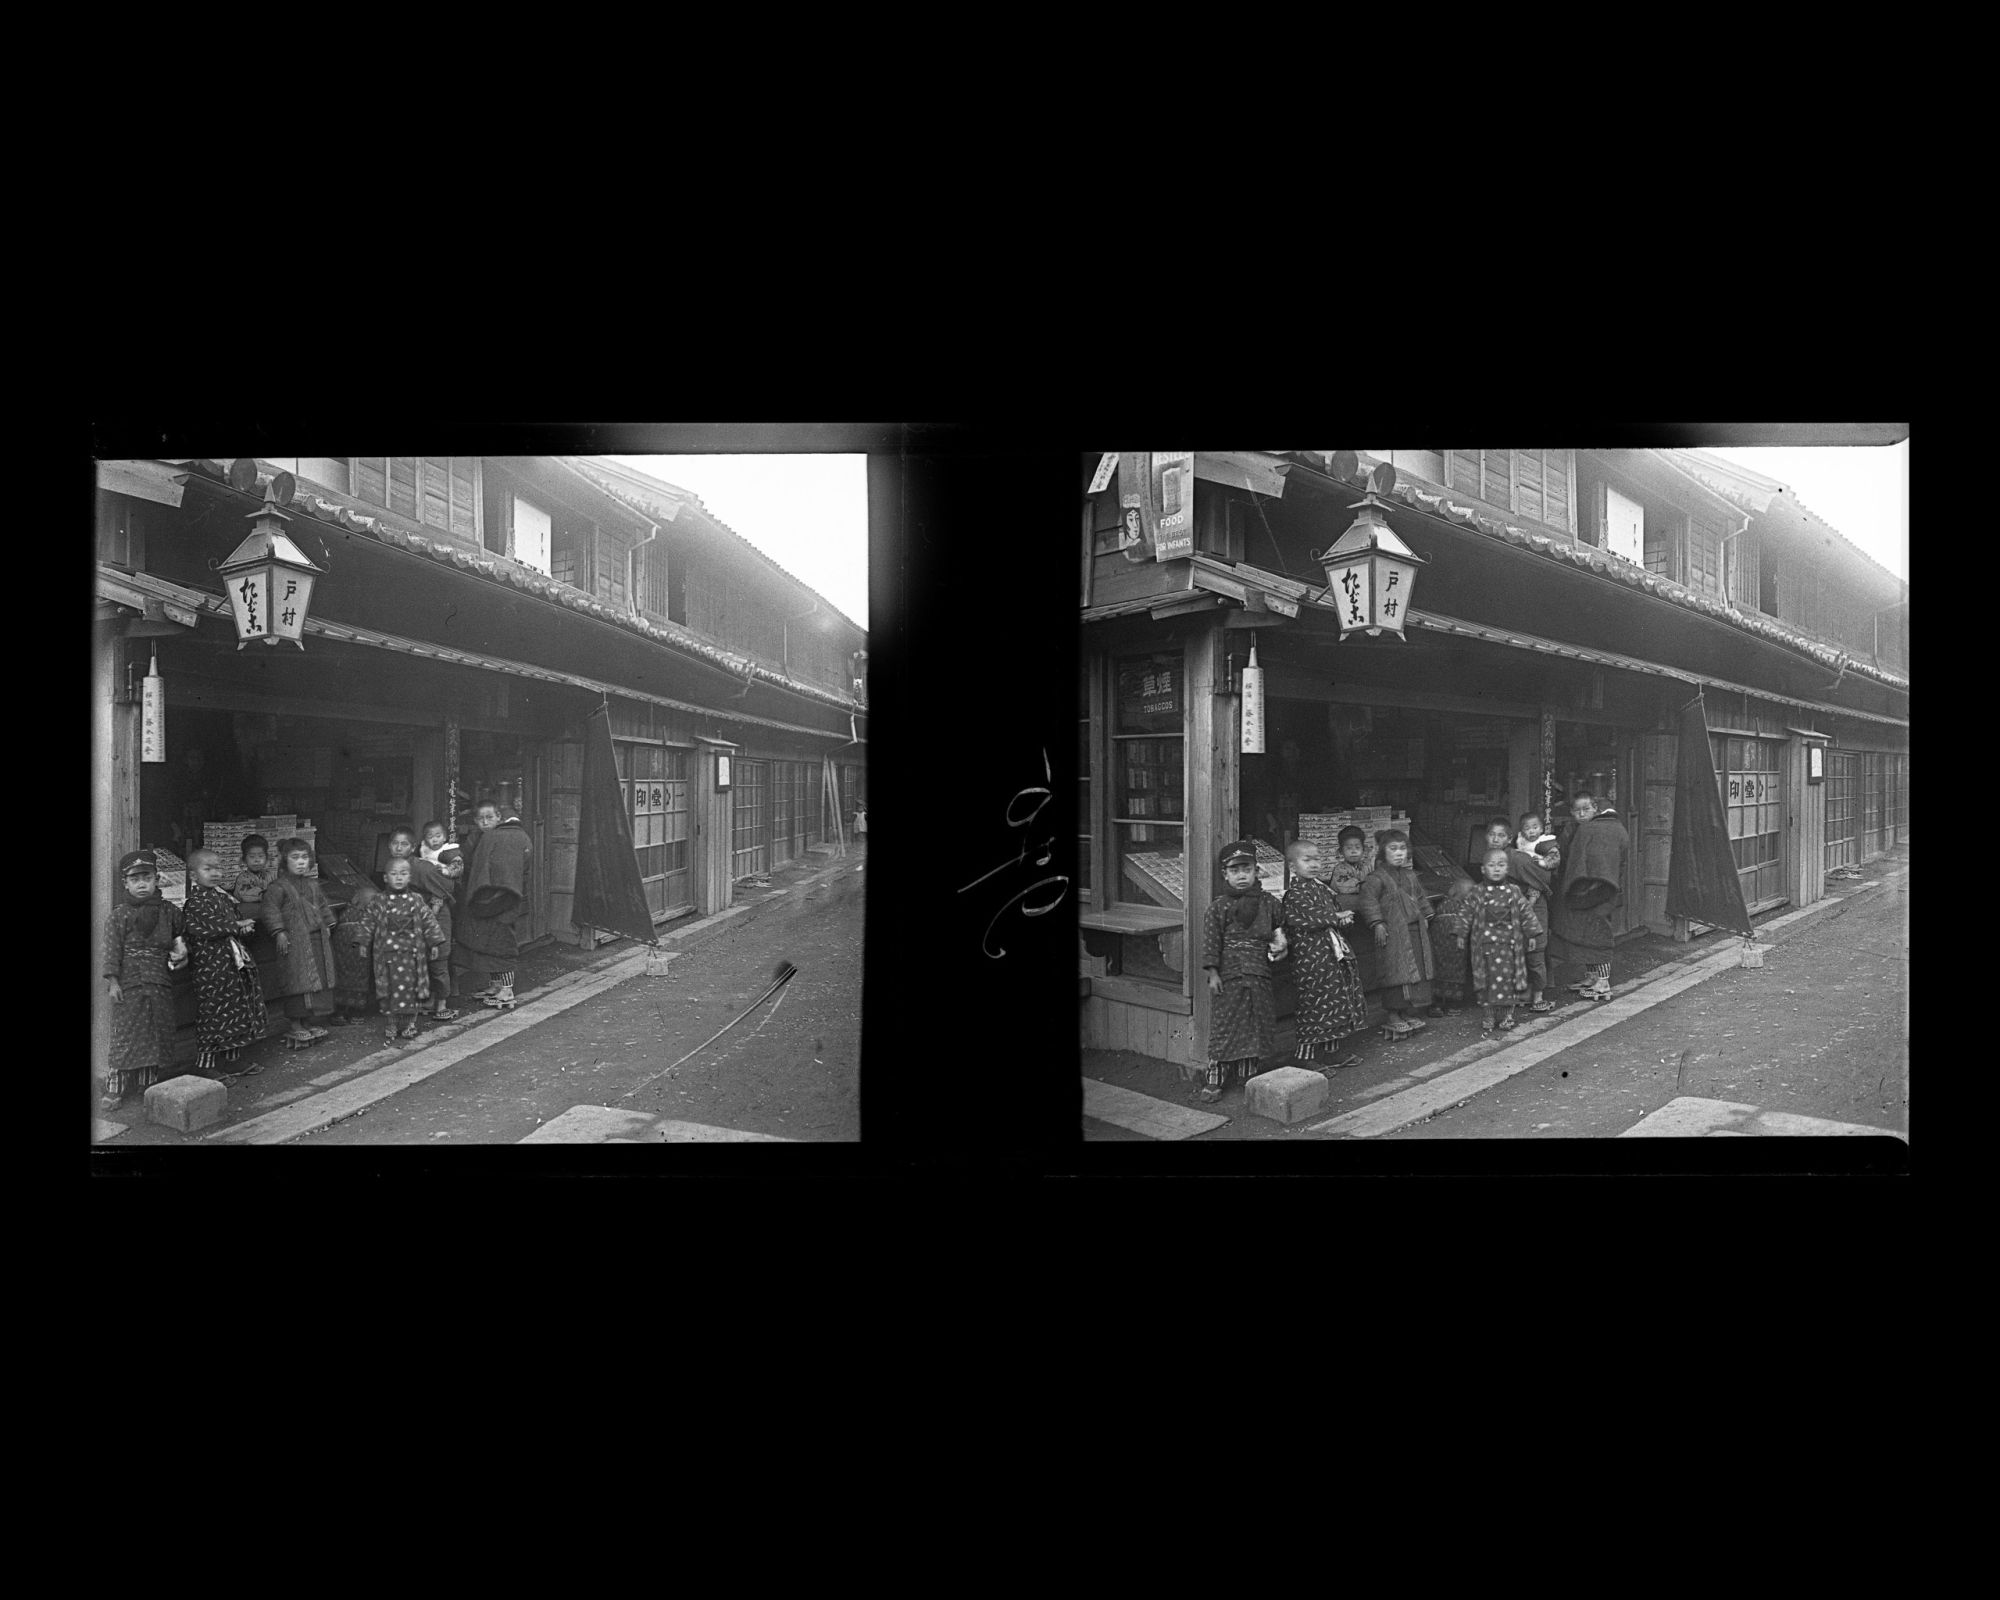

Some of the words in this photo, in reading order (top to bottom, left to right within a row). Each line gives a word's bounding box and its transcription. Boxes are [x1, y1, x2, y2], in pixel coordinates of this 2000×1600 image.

[1160, 515, 1184, 529] FOOD
[1156, 542, 1167, 551] FOR
[1167, 537, 1191, 550] INFANTS
[1383, 571, 1399, 618] 戸村
[281, 580, 297, 627] 戸村
[1143, 700, 1174, 713] TOBACCOS
